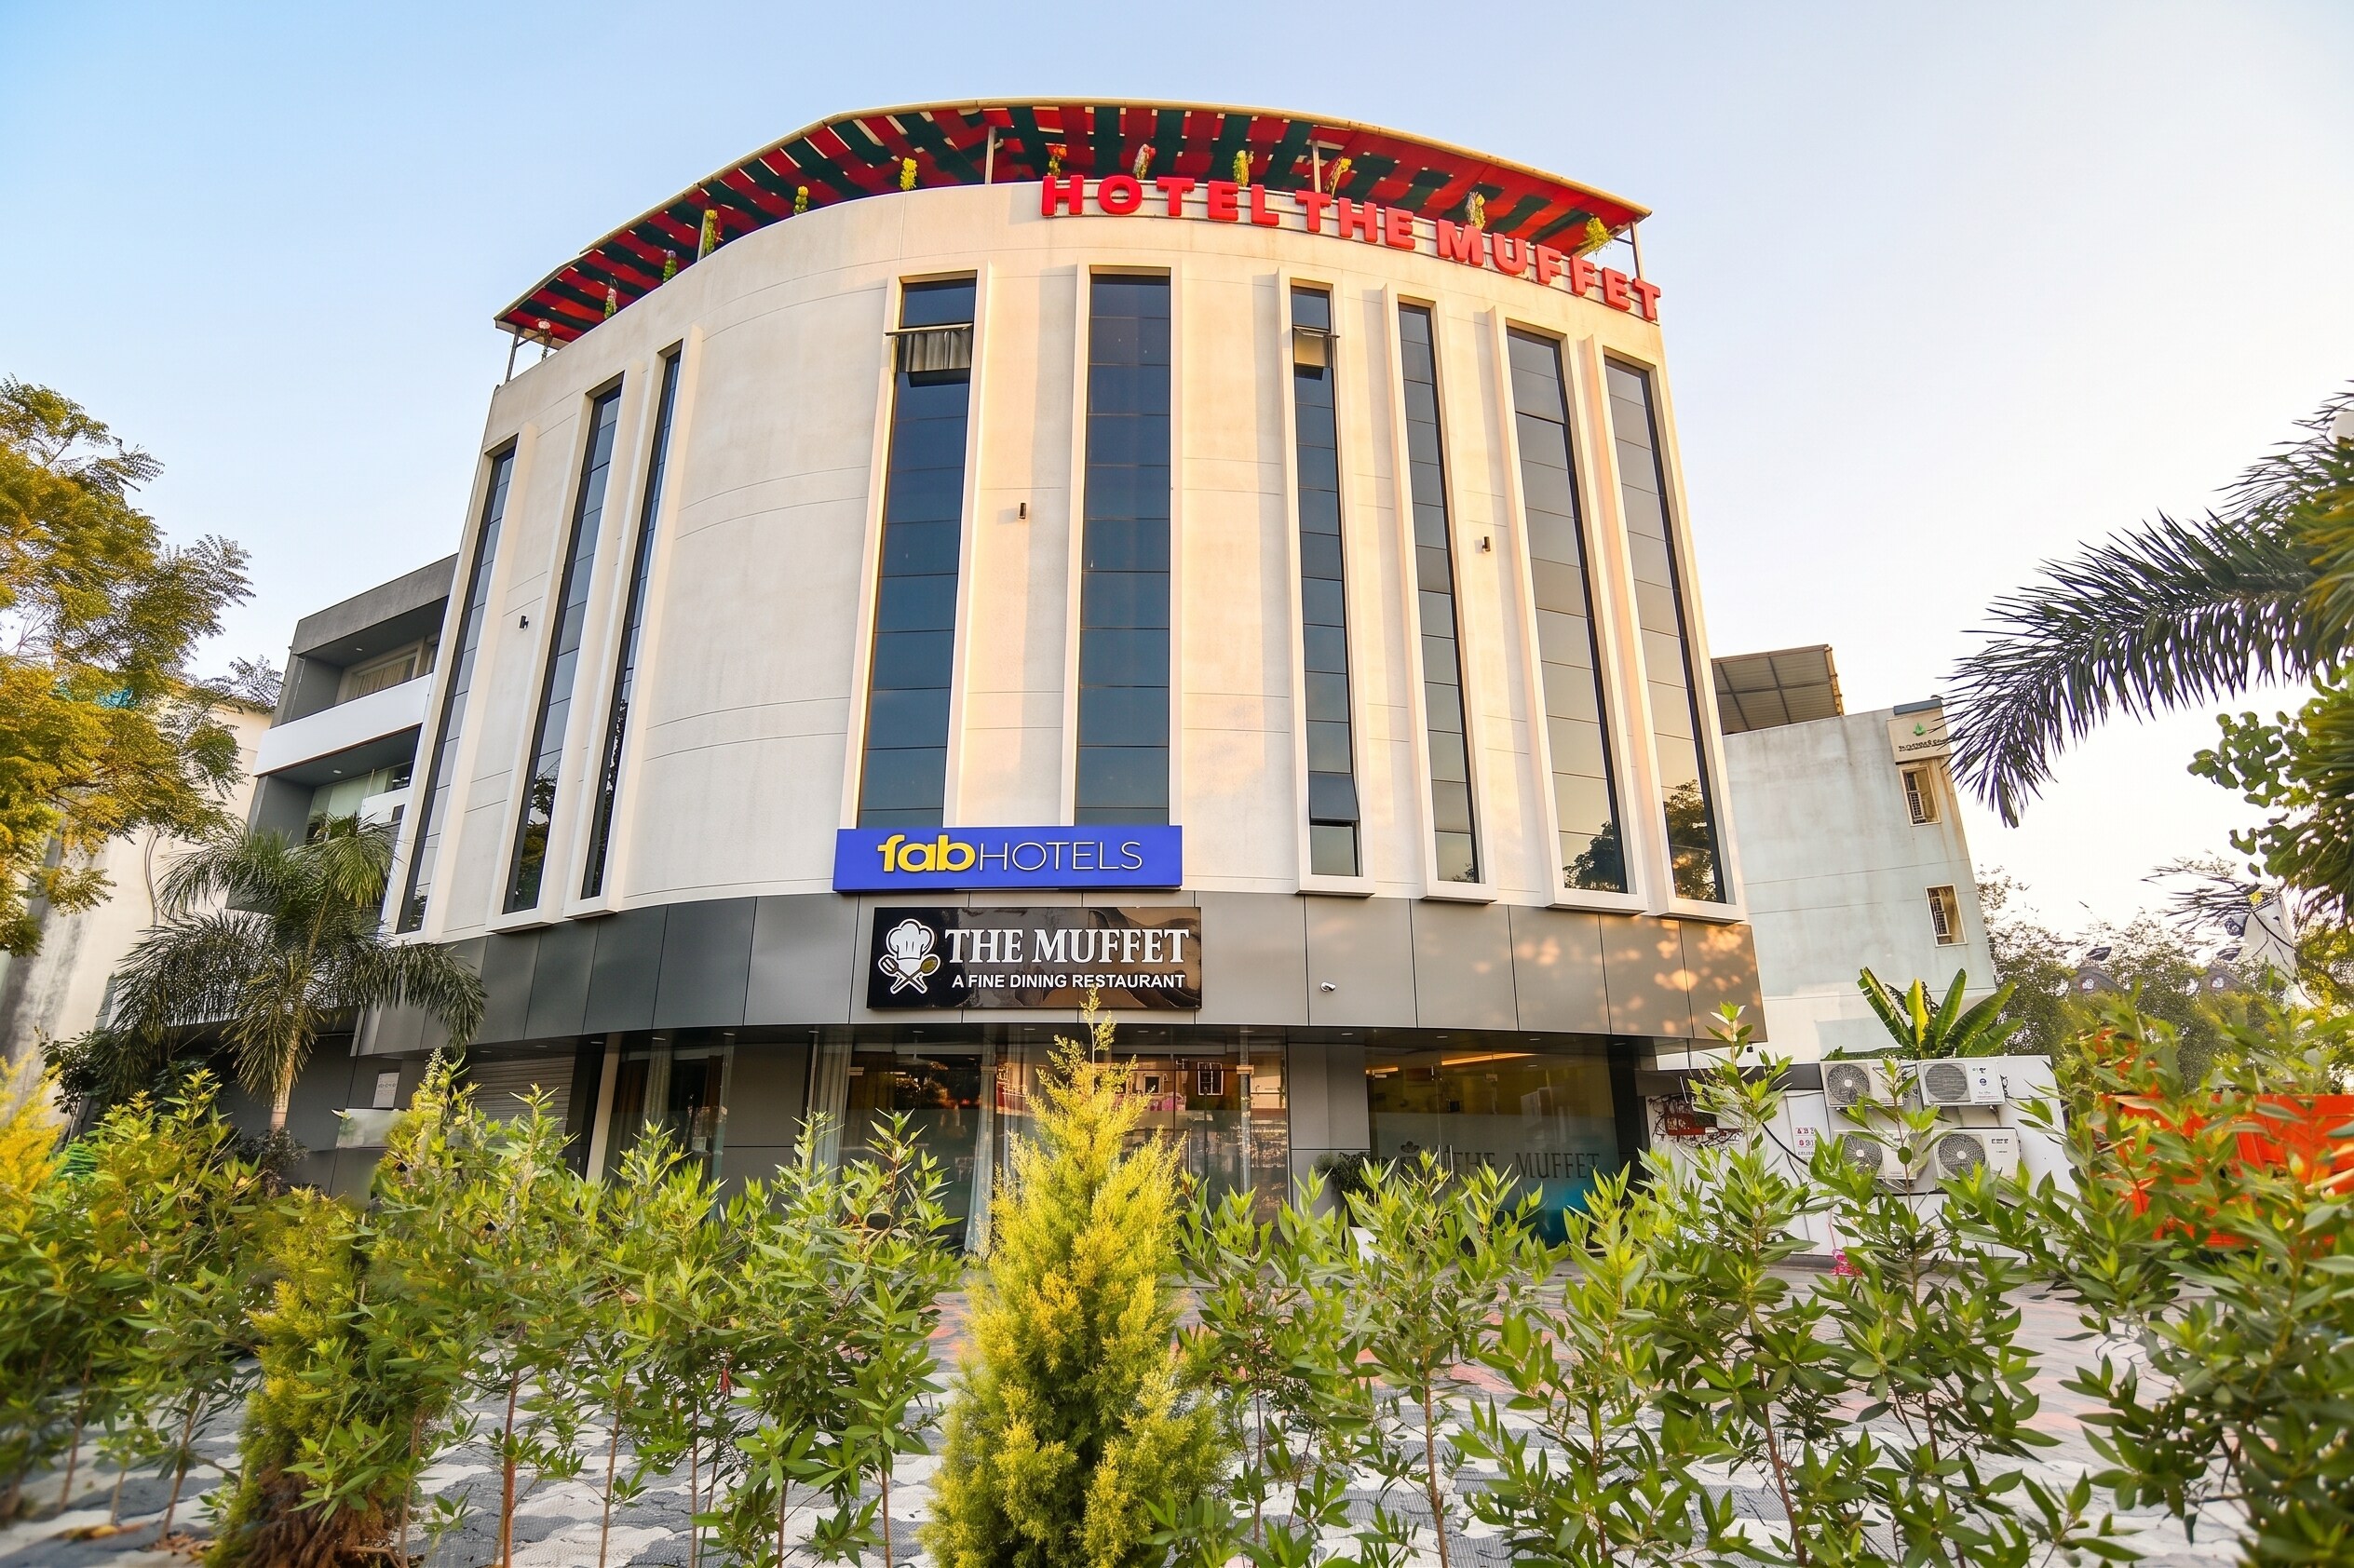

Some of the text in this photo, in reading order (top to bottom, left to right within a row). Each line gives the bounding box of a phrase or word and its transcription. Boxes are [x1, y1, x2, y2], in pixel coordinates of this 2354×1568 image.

[1040, 175, 1661, 322] HOTEL THE MUFFET
[877, 834, 1143, 872] fabHOTELS
[944, 928, 1190, 964] THE MUFFET
[952, 974, 1185, 989] A FINE DINING RESTAURANT
[1515, 1152, 1601, 1179] MUFFET
